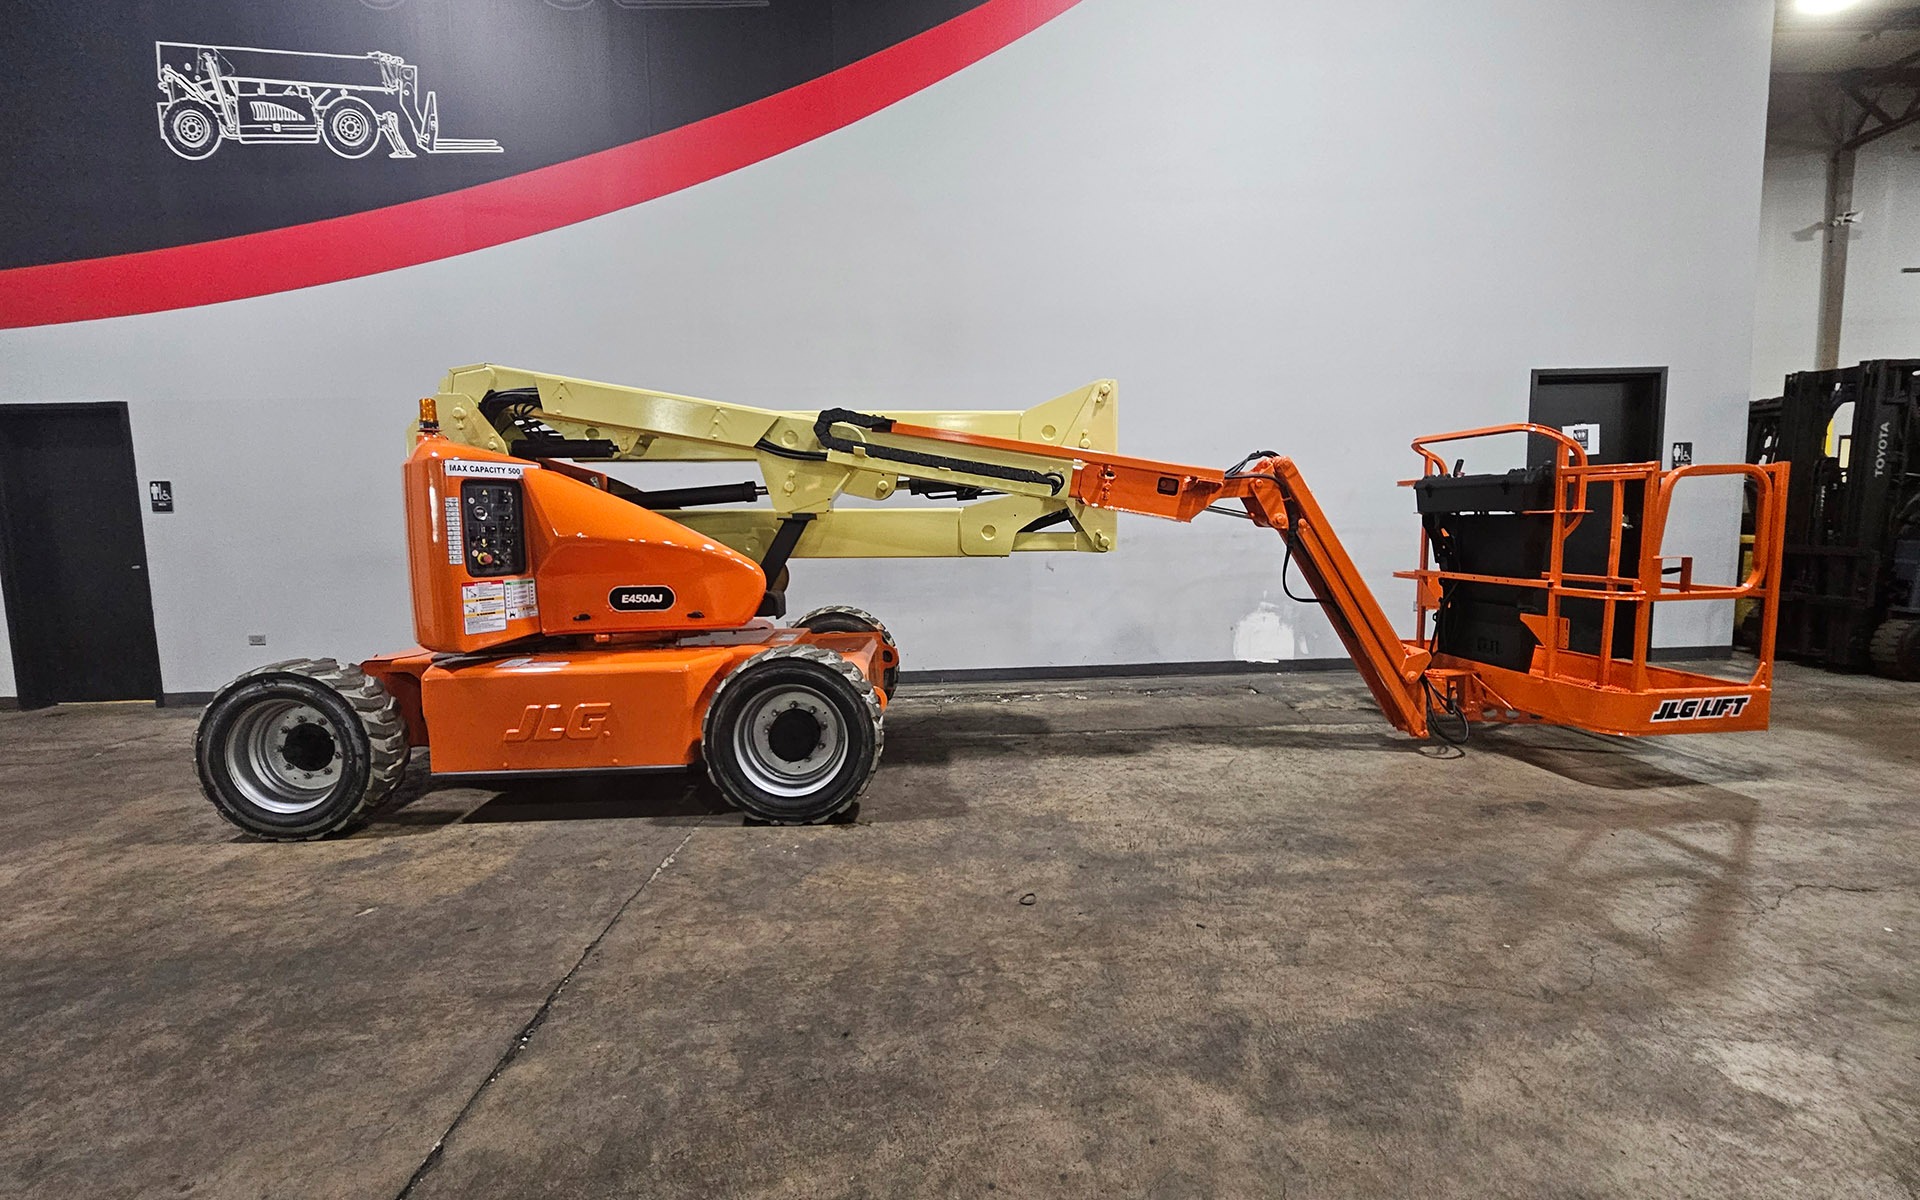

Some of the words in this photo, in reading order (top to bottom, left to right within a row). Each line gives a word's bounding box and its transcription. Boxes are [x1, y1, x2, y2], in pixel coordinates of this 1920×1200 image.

[1874, 421, 1890, 478] TOYOTA
[449, 464, 468, 472] MAX
[469, 465, 506, 474] CAPACITY
[621, 594, 663, 604] E450AJ
[1652, 700, 1700, 721] JLG
[1698, 697, 1750, 718] LIFT
